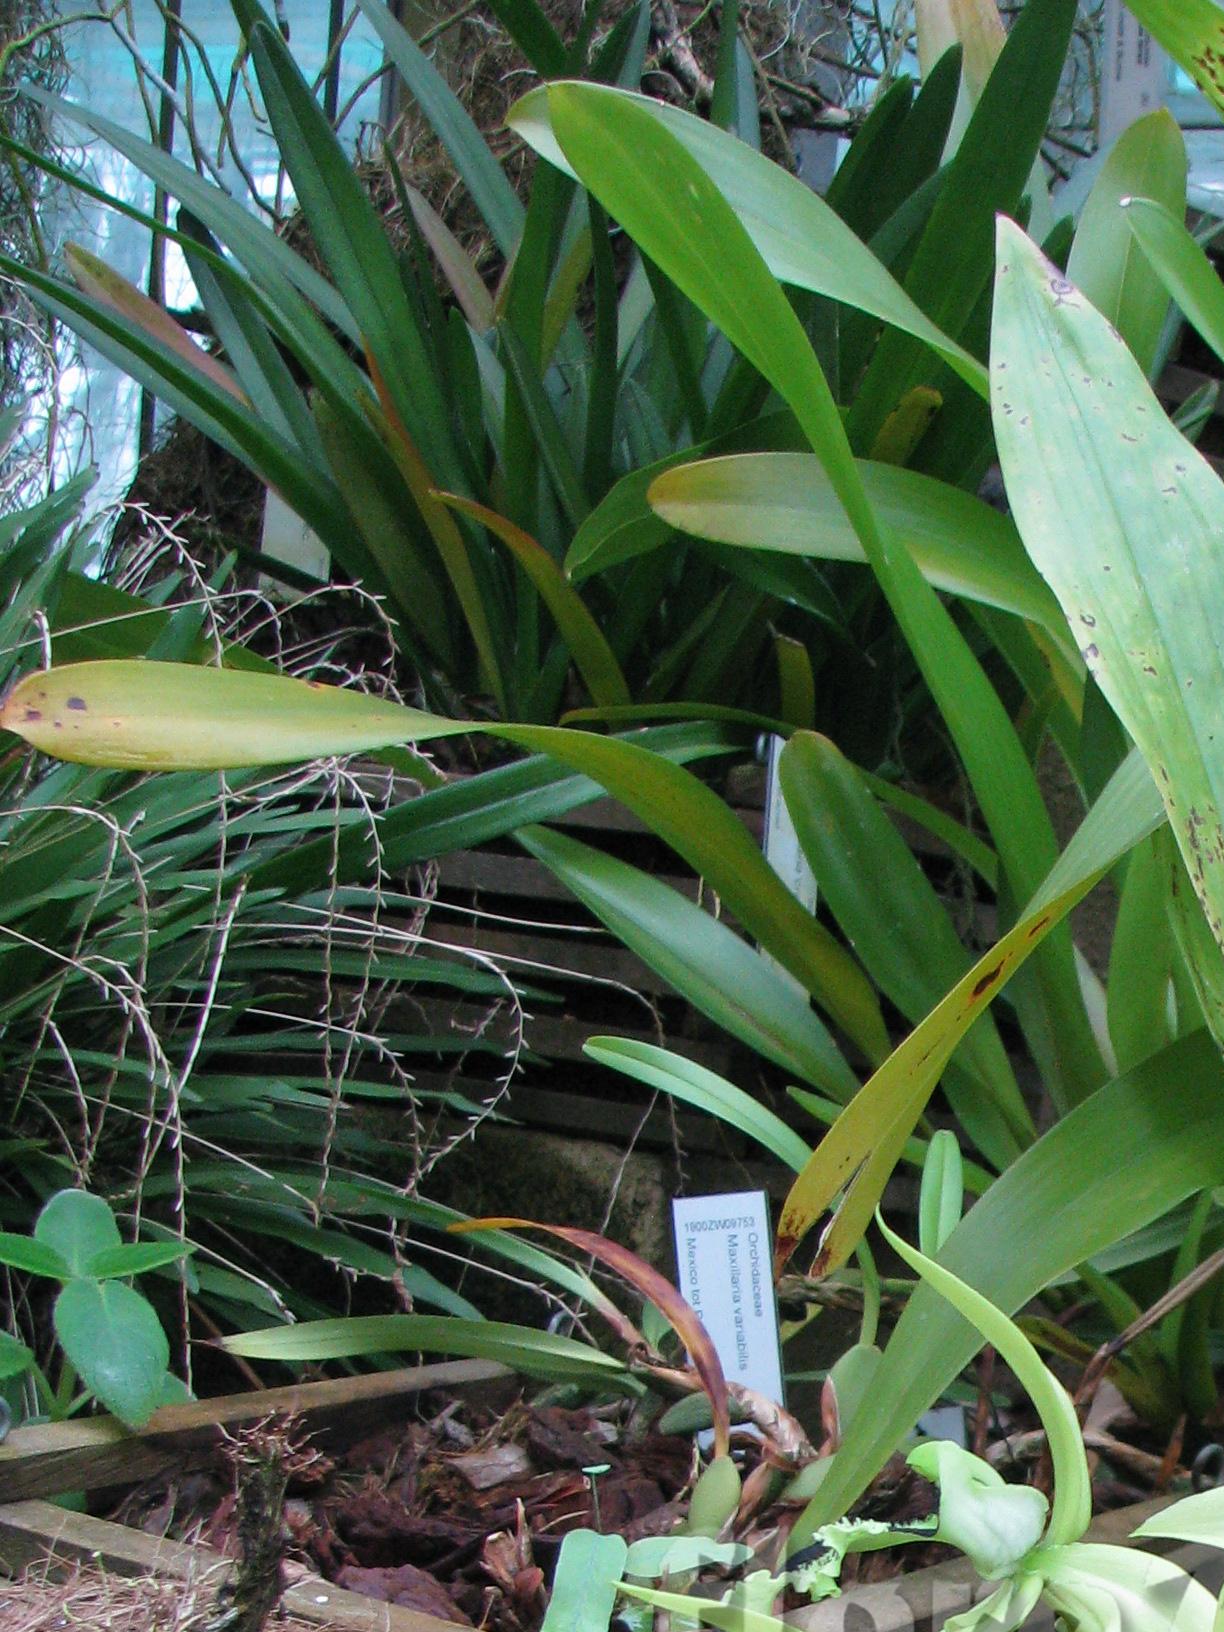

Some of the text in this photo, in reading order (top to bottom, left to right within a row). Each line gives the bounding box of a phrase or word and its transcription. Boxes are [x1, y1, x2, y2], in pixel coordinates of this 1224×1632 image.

[686, 1237, 699, 1286] Mexico
[727, 1233, 748, 1372] Maxillaria variabilis
[747, 1231, 764, 1318] Orchidaceae
